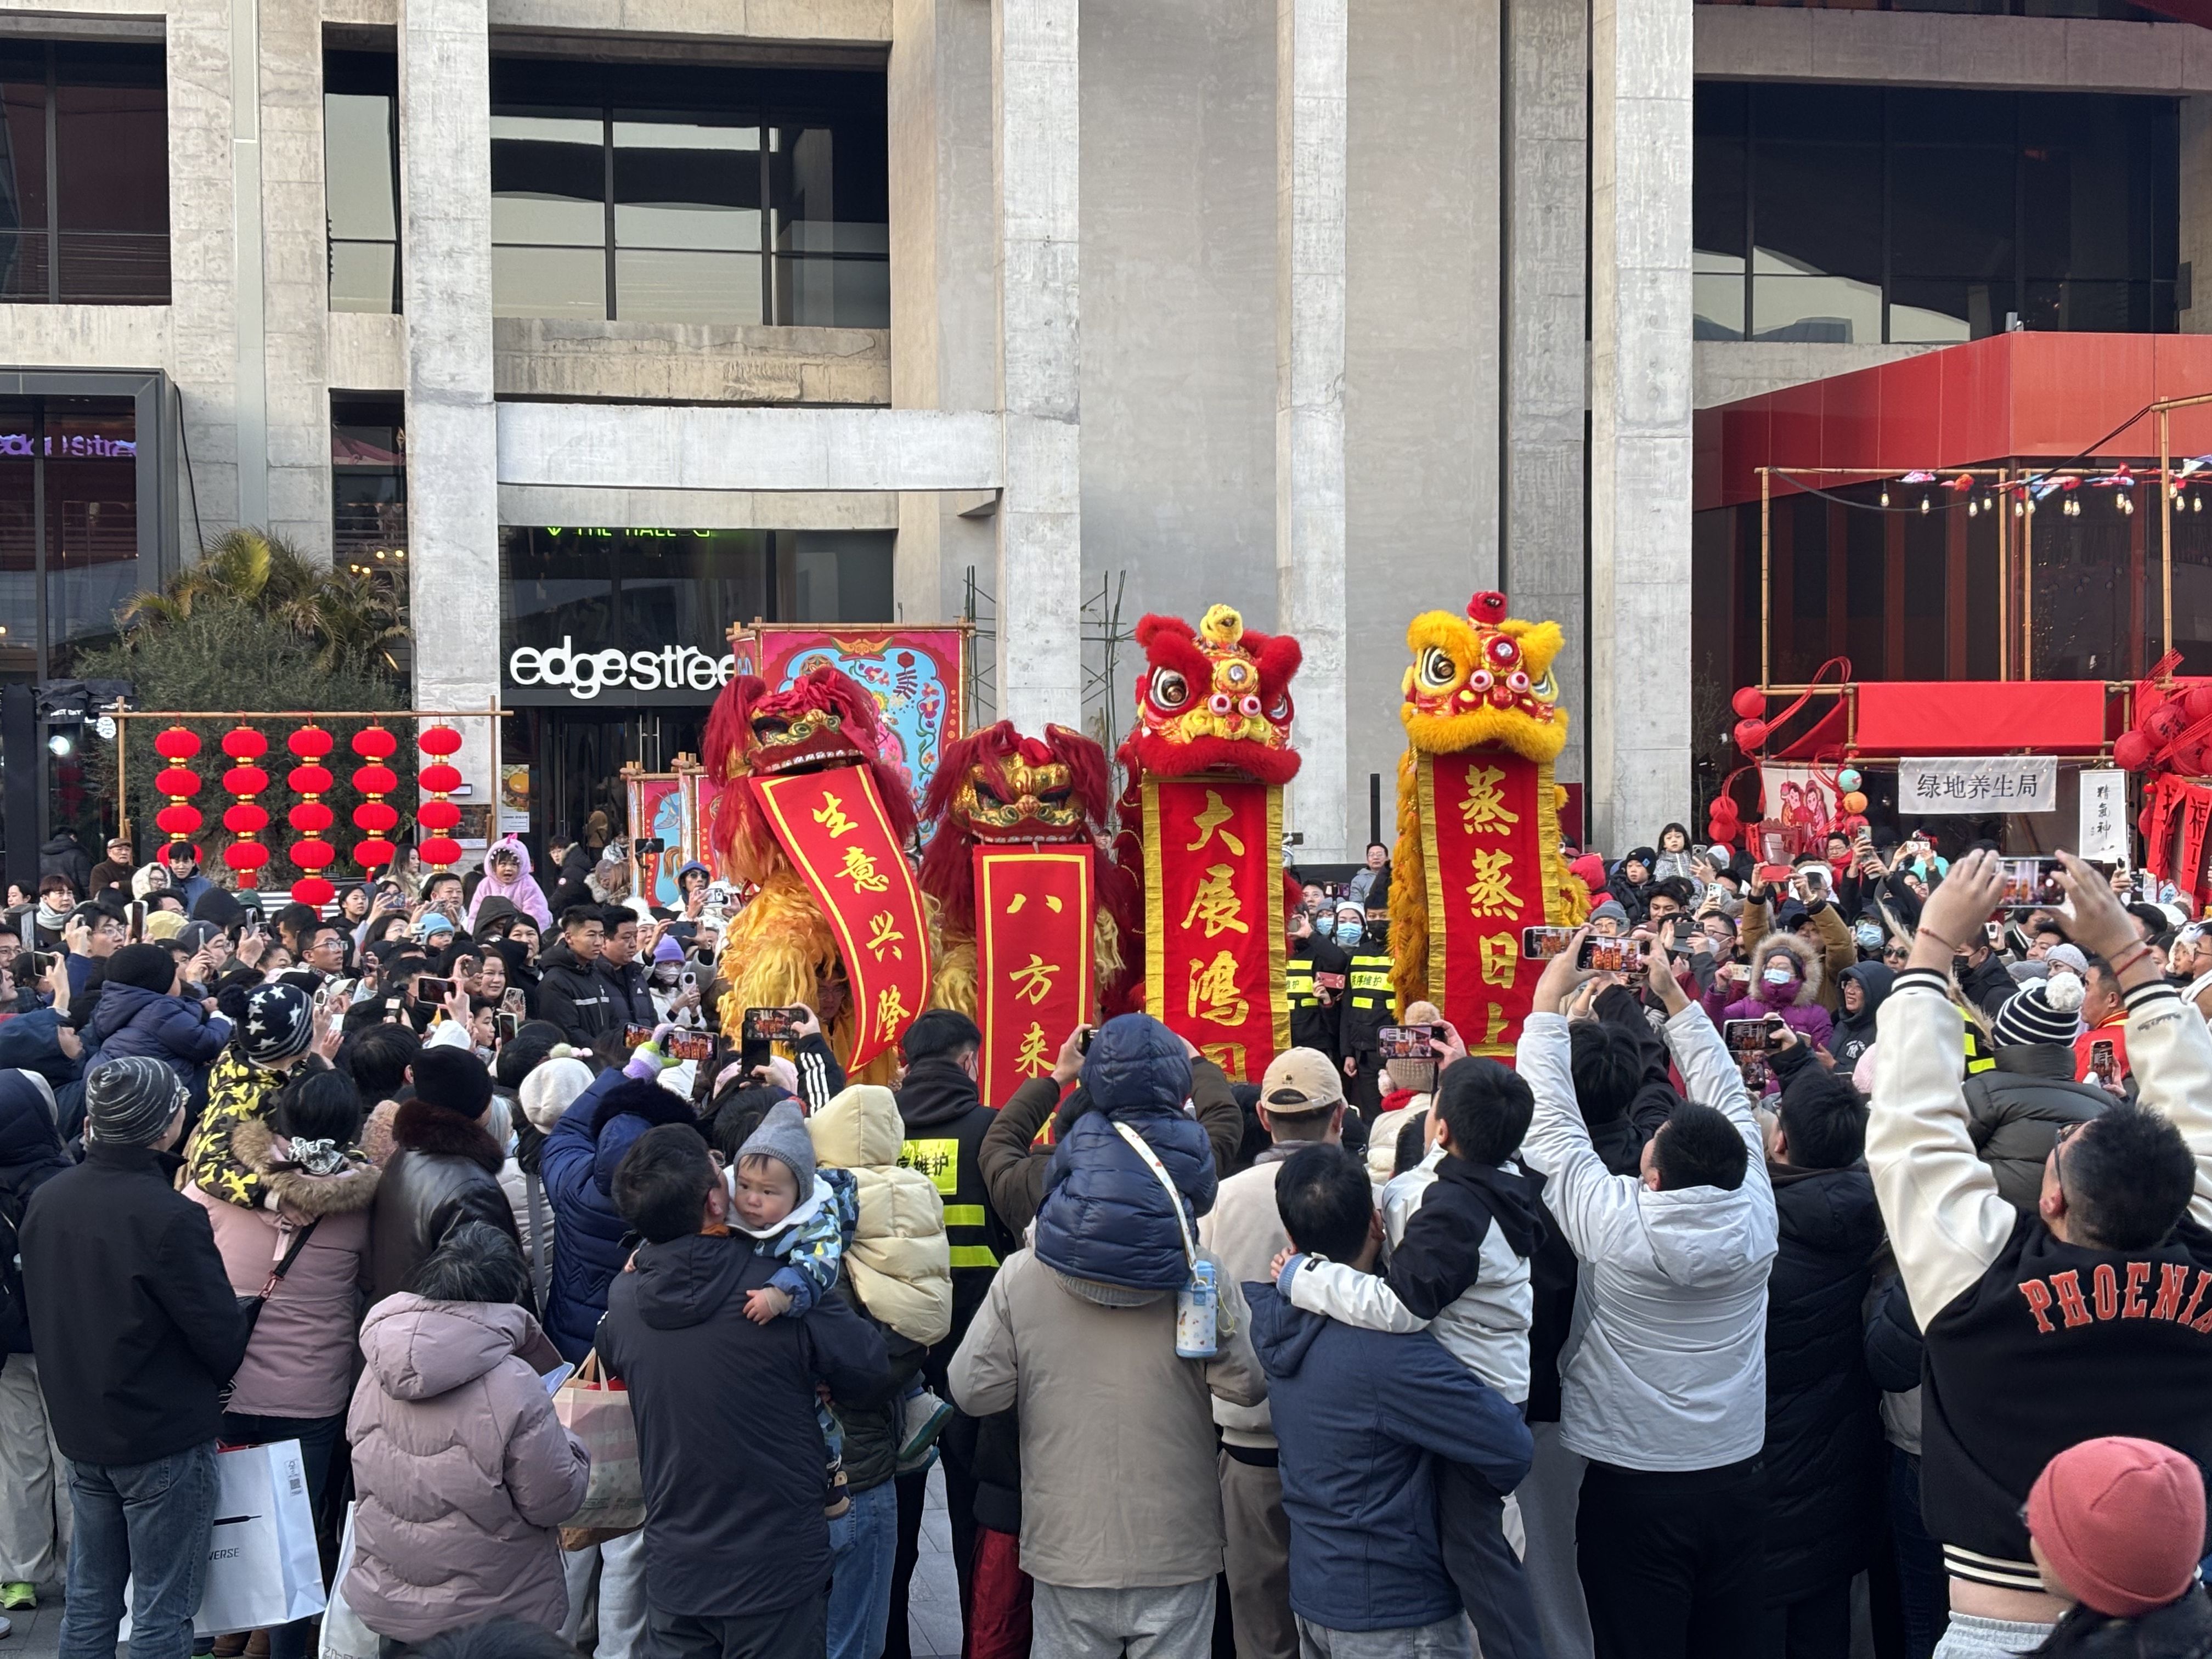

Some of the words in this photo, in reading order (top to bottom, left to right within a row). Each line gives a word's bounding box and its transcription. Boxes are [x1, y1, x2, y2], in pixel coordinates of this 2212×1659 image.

[1458, 763, 1524, 1057] 蒸蒸日上
[1916, 774, 2038, 799] 绿地养生局
[812, 791, 911, 1043] 生意兴隆
